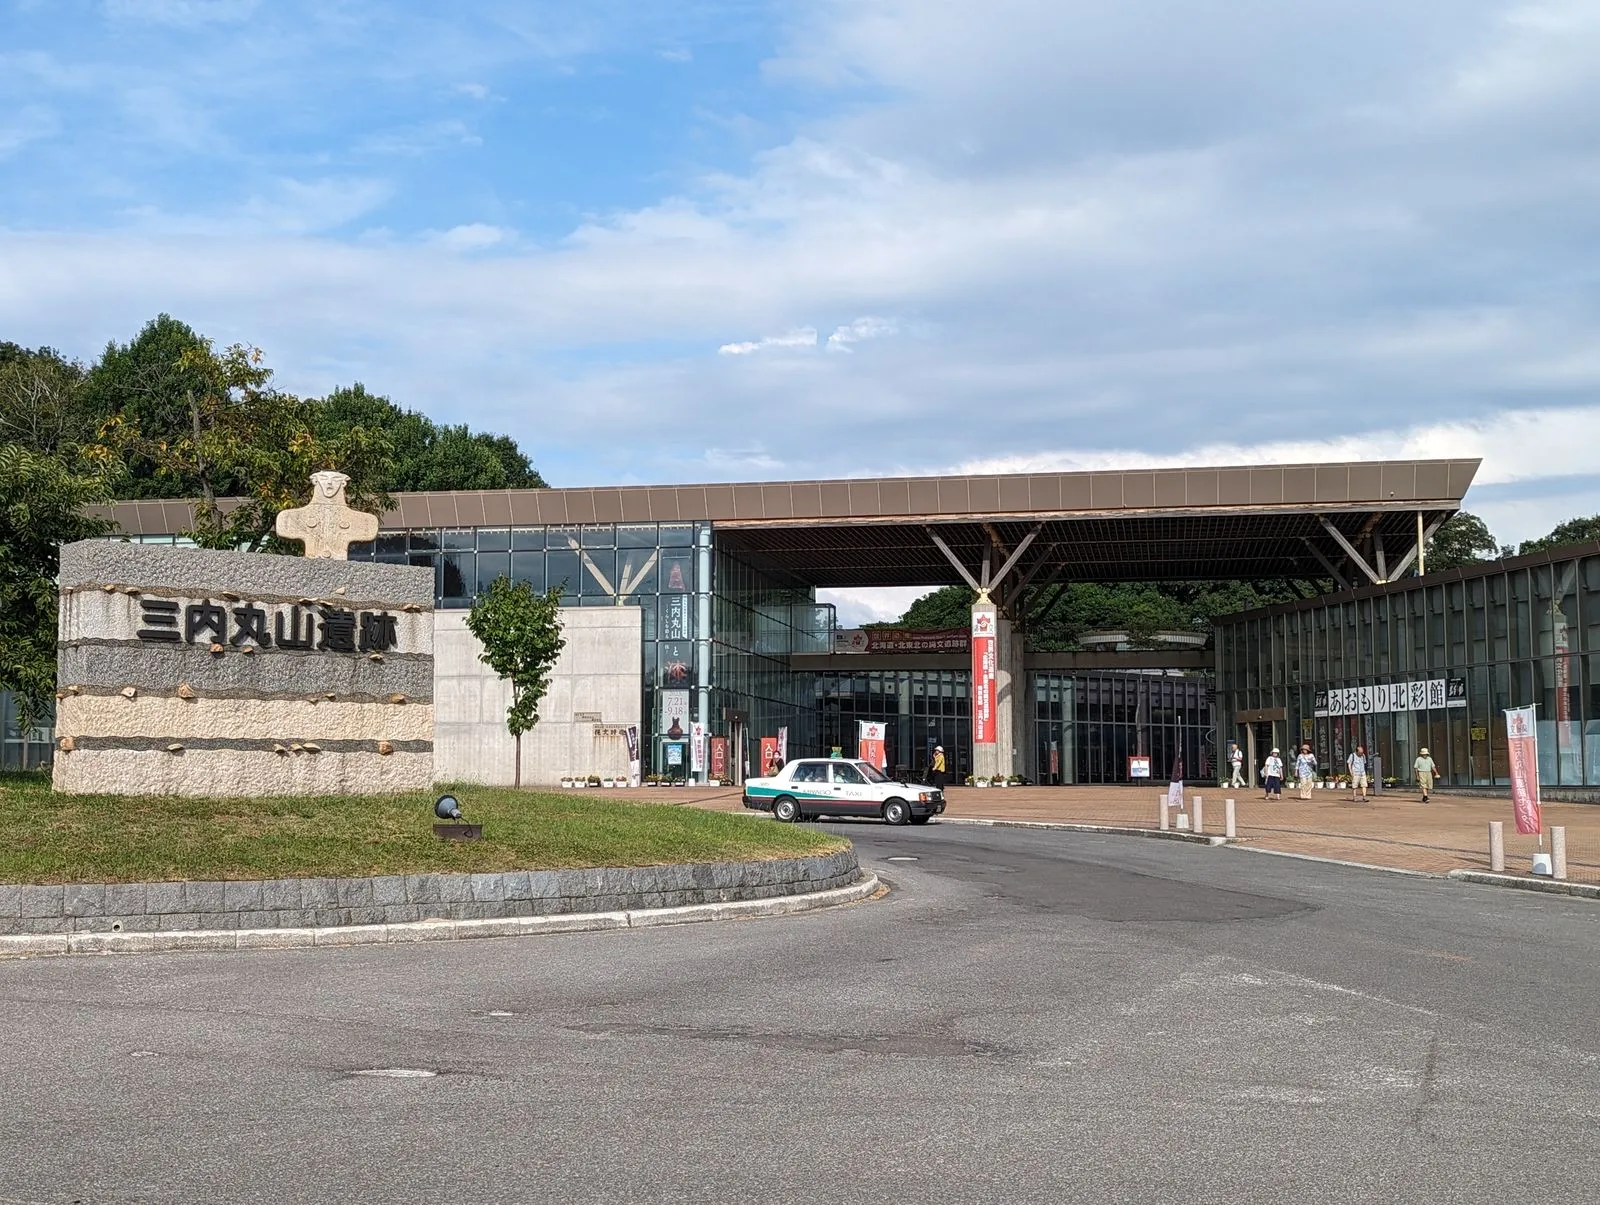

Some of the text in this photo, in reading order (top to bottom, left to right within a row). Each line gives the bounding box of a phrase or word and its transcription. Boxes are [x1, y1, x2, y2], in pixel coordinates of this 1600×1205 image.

[136, 598, 398, 652] 三内丸山遺跡
[1330, 681, 1443, 714] あおもり北彩館
[716, 743, 724, 759] 入口
[765, 743, 773, 759] 入口
